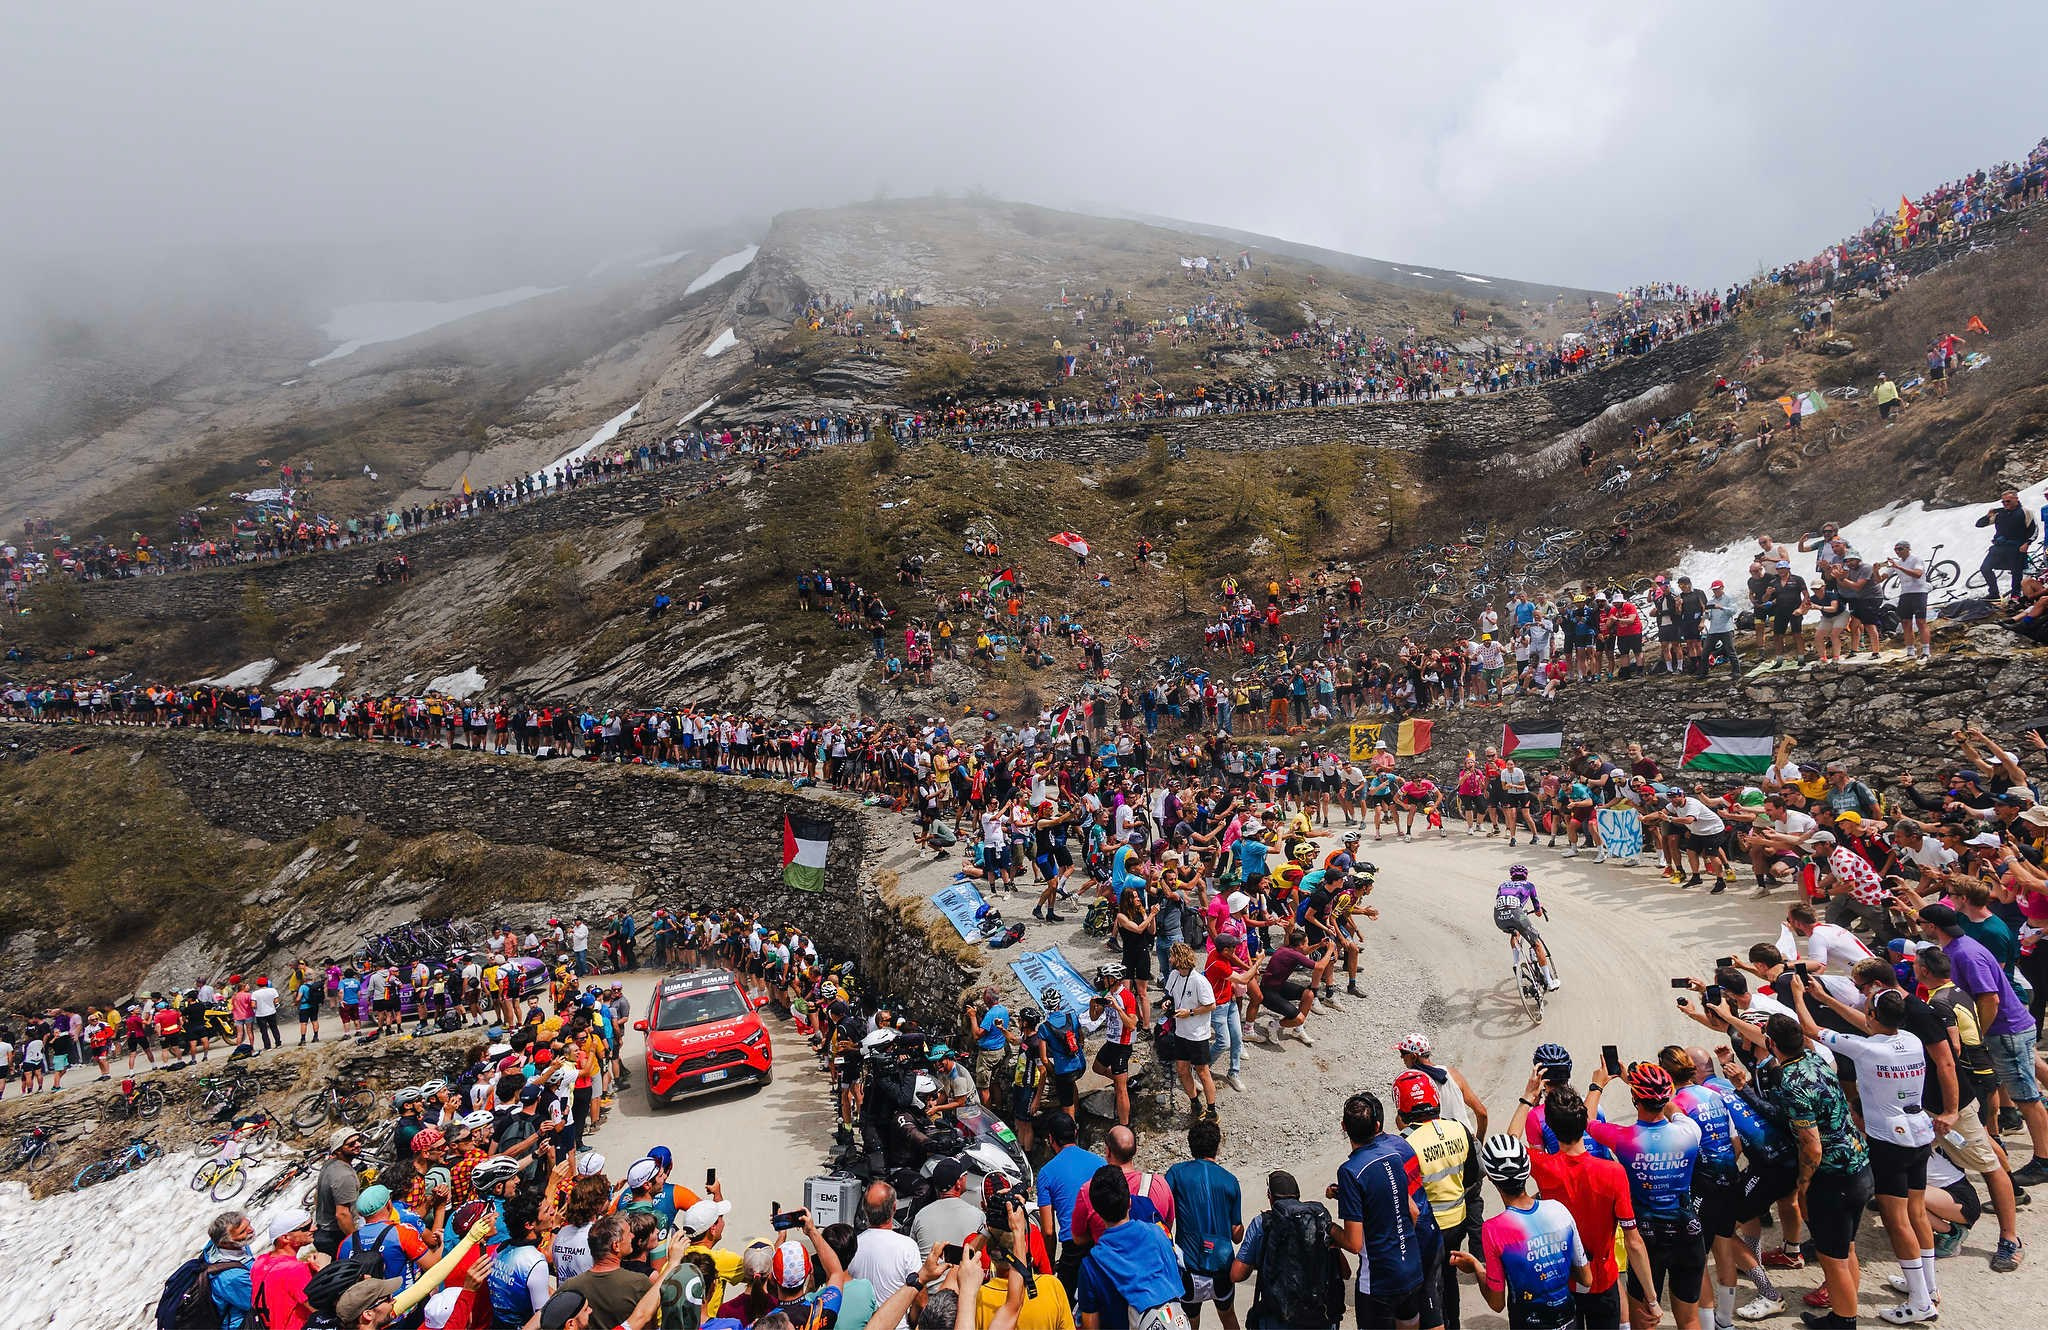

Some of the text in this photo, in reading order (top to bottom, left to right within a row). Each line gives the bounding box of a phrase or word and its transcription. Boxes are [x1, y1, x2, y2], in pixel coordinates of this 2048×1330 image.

[681, 1029, 735, 1043] TOYOTA
[1876, 1064, 1889, 1072] TRE
[1890, 1064, 1907, 1072] VALLI
[1423, 1137, 1464, 1163] SCORTA TECNICA
[1635, 1151, 1685, 1161] POLITO
[1631, 1159, 1688, 1171] CYCLING
[820, 1193, 838, 1203] EMG
[1526, 1232, 1563, 1251] POLITO
[554, 1245, 586, 1256] BELTRAMI
[1526, 1240, 1568, 1262] CYCLING
